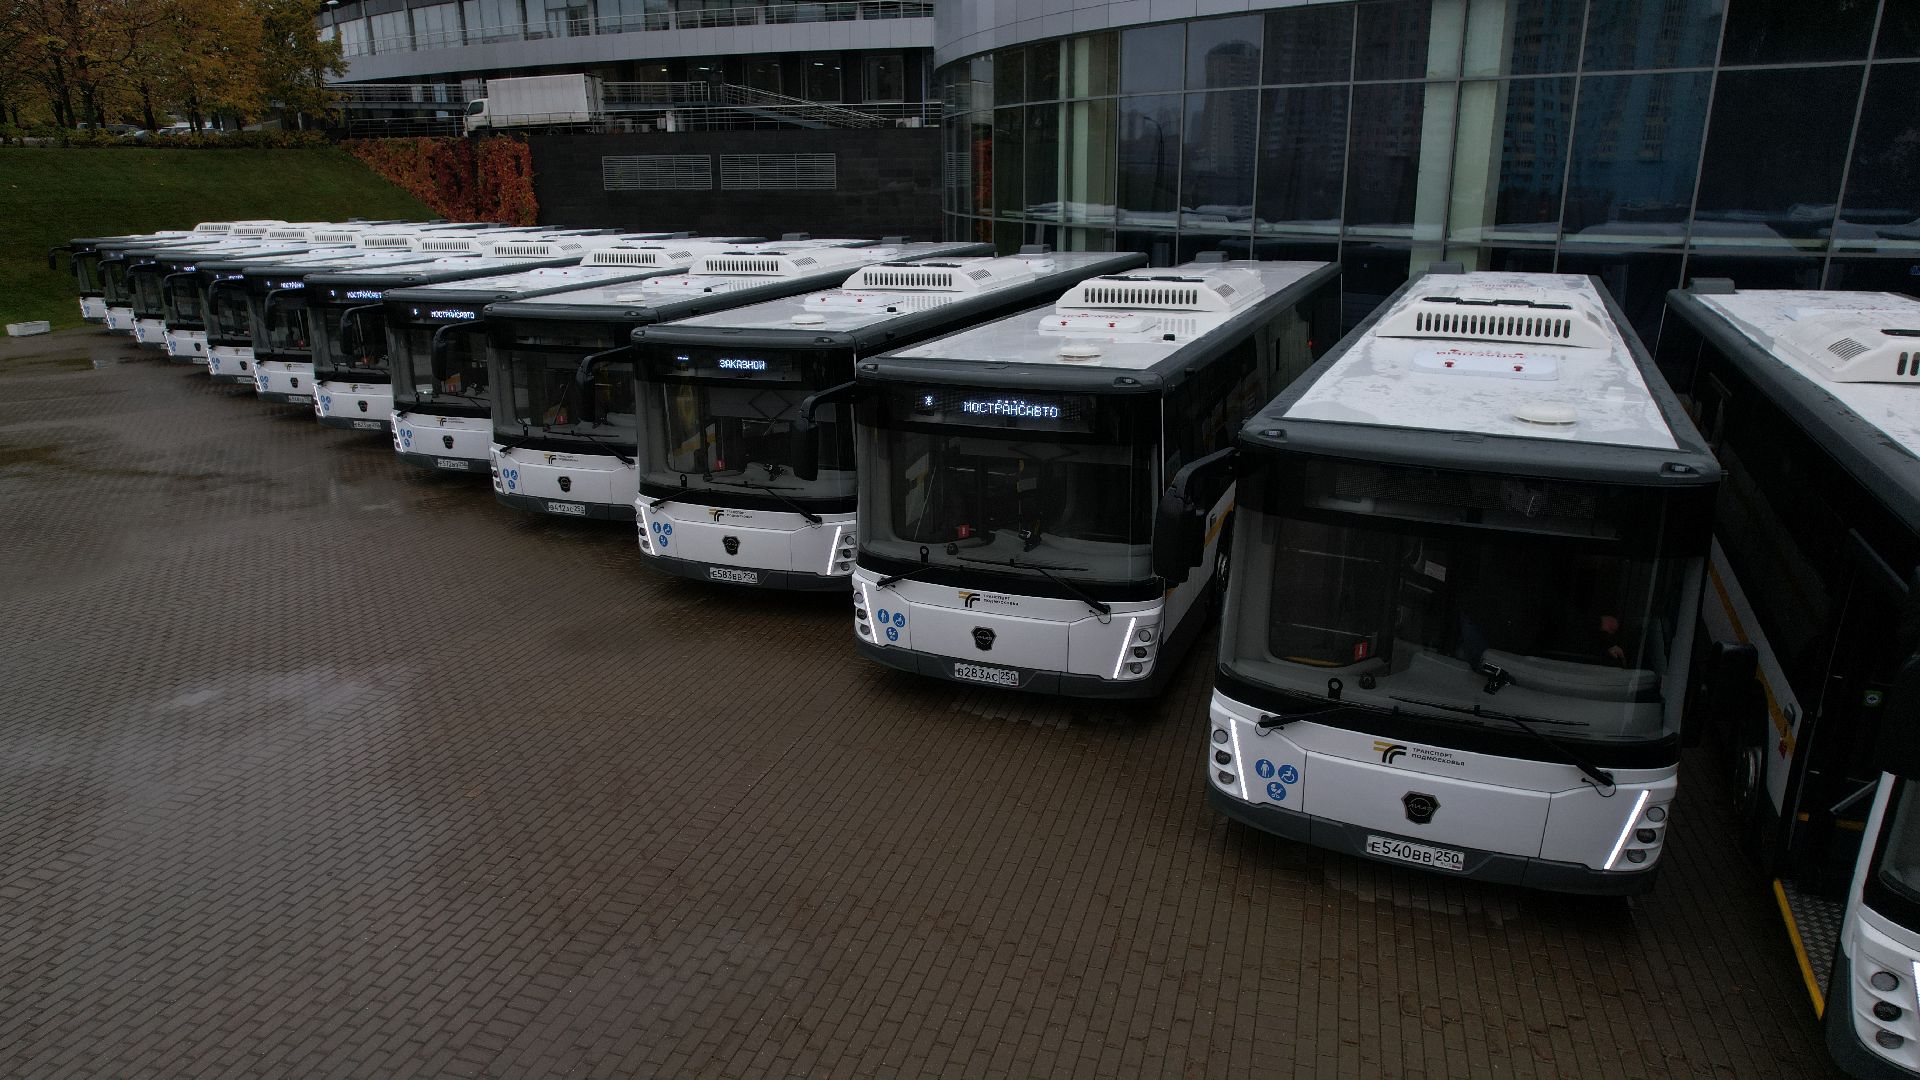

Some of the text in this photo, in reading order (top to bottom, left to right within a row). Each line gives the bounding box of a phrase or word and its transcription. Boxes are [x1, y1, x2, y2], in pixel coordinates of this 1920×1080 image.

[719, 359, 766, 370] ЗАКАЗНОЙ
[963, 400, 1058, 418] МОСТРАНСАВТО
[1411, 753, 1465, 766] ПОДМОСКОВЬЯ
[1412, 747, 1453, 759] ТРАНСПОРТ
[1371, 841, 1460, 864] Е540ВВ 250
